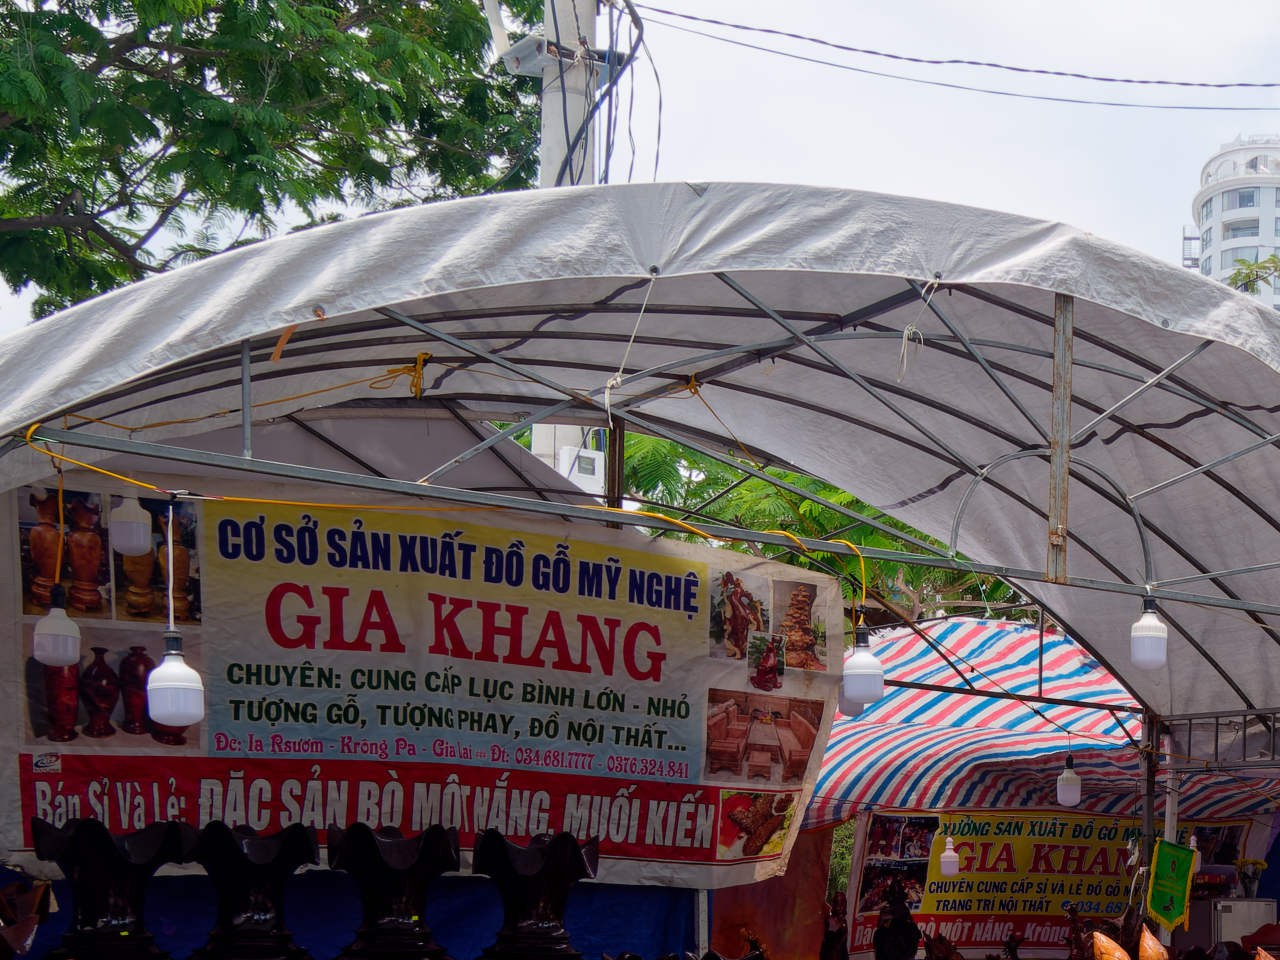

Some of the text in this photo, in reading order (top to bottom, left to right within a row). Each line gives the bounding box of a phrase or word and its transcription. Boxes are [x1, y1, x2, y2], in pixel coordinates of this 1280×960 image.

[218, 515, 699, 619] CƠ SỞ SẢN XUẤT ĐỒ GỖ MỸ NGHỆ
[265, 582, 666, 682] GIA KHANG
[227, 661, 341, 689] CHUYÊN:
[351, 668, 416, 692] CUNG
[425, 666, 462, 694] CẤP
[468, 677, 513, 703] LỤC
[521, 679, 575, 707] BÌNH
[583, 686, 625, 712] LỚN
[647, 693, 690, 719] NHỎ
[229, 697, 317, 727] TƯỢNG
[326, 693, 367, 729] GỖ,
[376, 703, 454, 731] TƯỢNG
[457, 710, 521, 740] PHAY,
[529, 711, 560, 739] ĐỒ
[567, 718, 604, 749] NỘI
[340, 736, 388, 759] Krông
[395, 738, 416, 756] Pa
[433, 739, 456, 757] Gia
[34, 780, 81, 830] Bán
[115, 781, 146, 830] Và
[280, 764, 349, 830] SẢN
[356, 769, 404, 830] BÒ
[563, 785, 640, 844] MUỐI
[645, 790, 715, 849] KIẾN
[953, 842, 1016, 873] GIA
[928, 878, 974, 894] CHUYÊN
[977, 881, 1008, 894] CUNG
[1010, 877, 1034, 894] CẤP
[936, 899, 973, 912] TRANG
[1021, 895, 1052, 912] THẤT
[972, 916, 1014, 942] NẮNG
